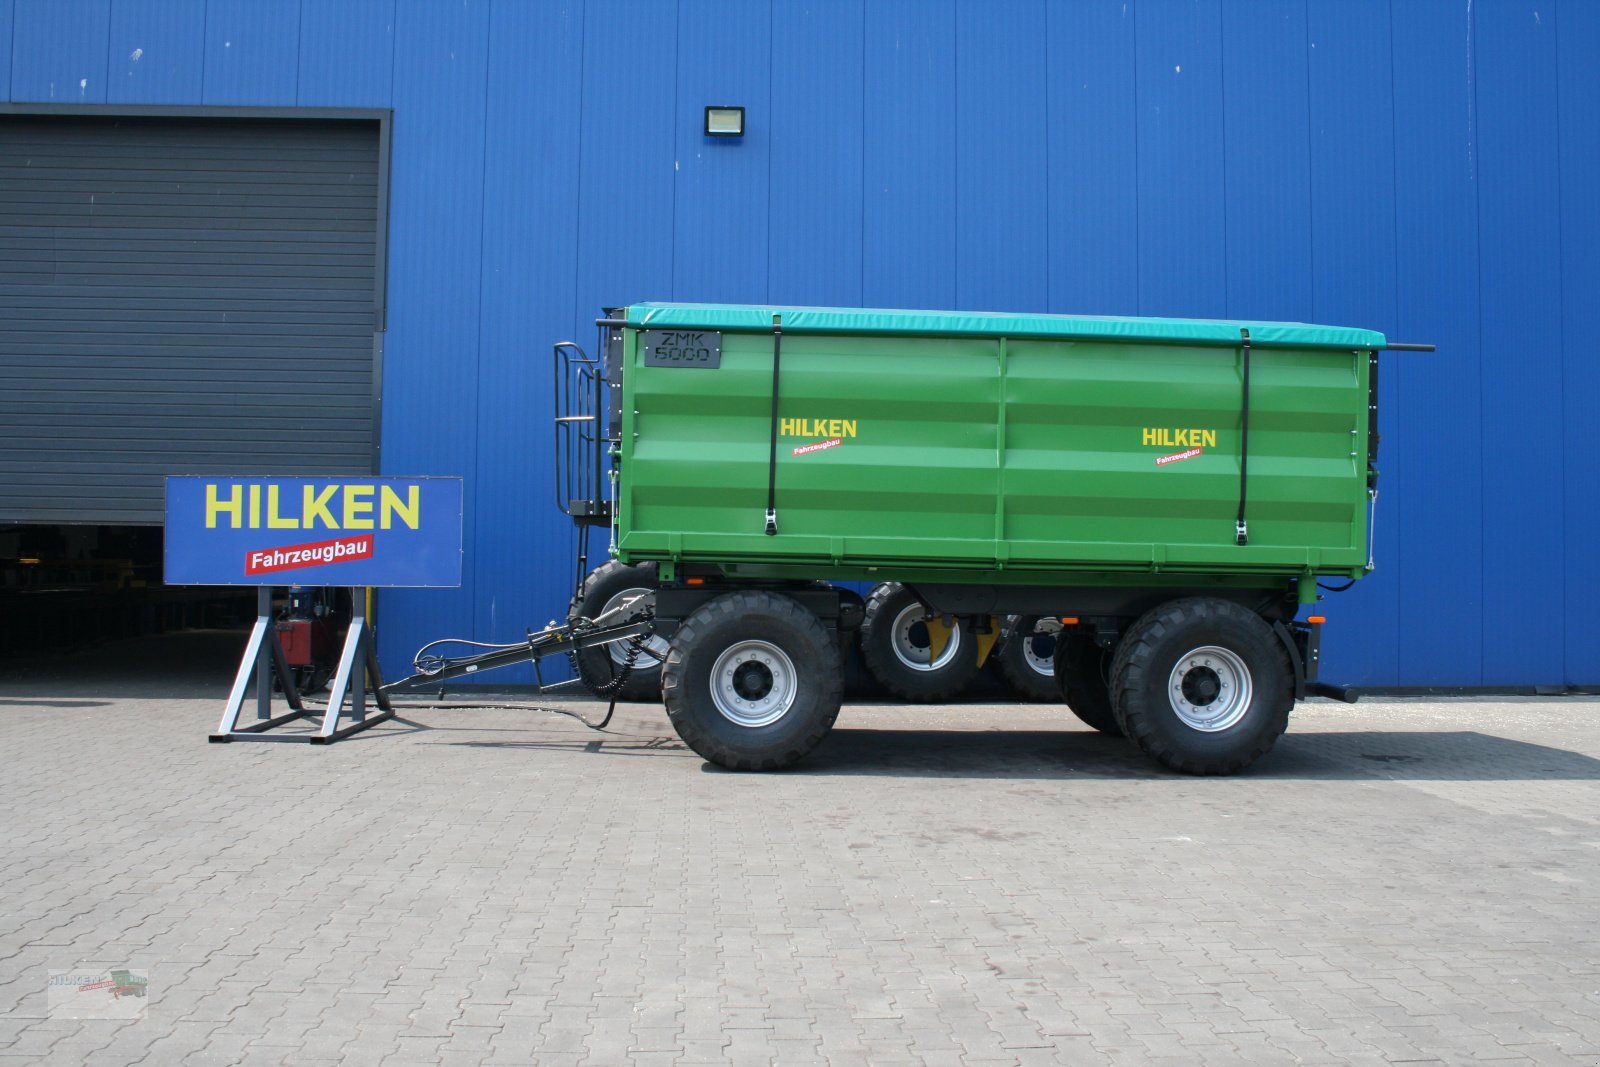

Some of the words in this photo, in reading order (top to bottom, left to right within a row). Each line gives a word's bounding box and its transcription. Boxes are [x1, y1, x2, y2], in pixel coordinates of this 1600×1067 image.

[661, 332, 705, 347] ZMK
[780, 418, 857, 438] HILKEN
[1142, 427, 1216, 447] HILKEN
[794, 439, 840, 455] Fahrzeugbau
[1156, 448, 1200, 465] Fahrzeugbau
[205, 484, 420, 530] HILKEN
[251, 539, 368, 569] Fahrzeugbau
